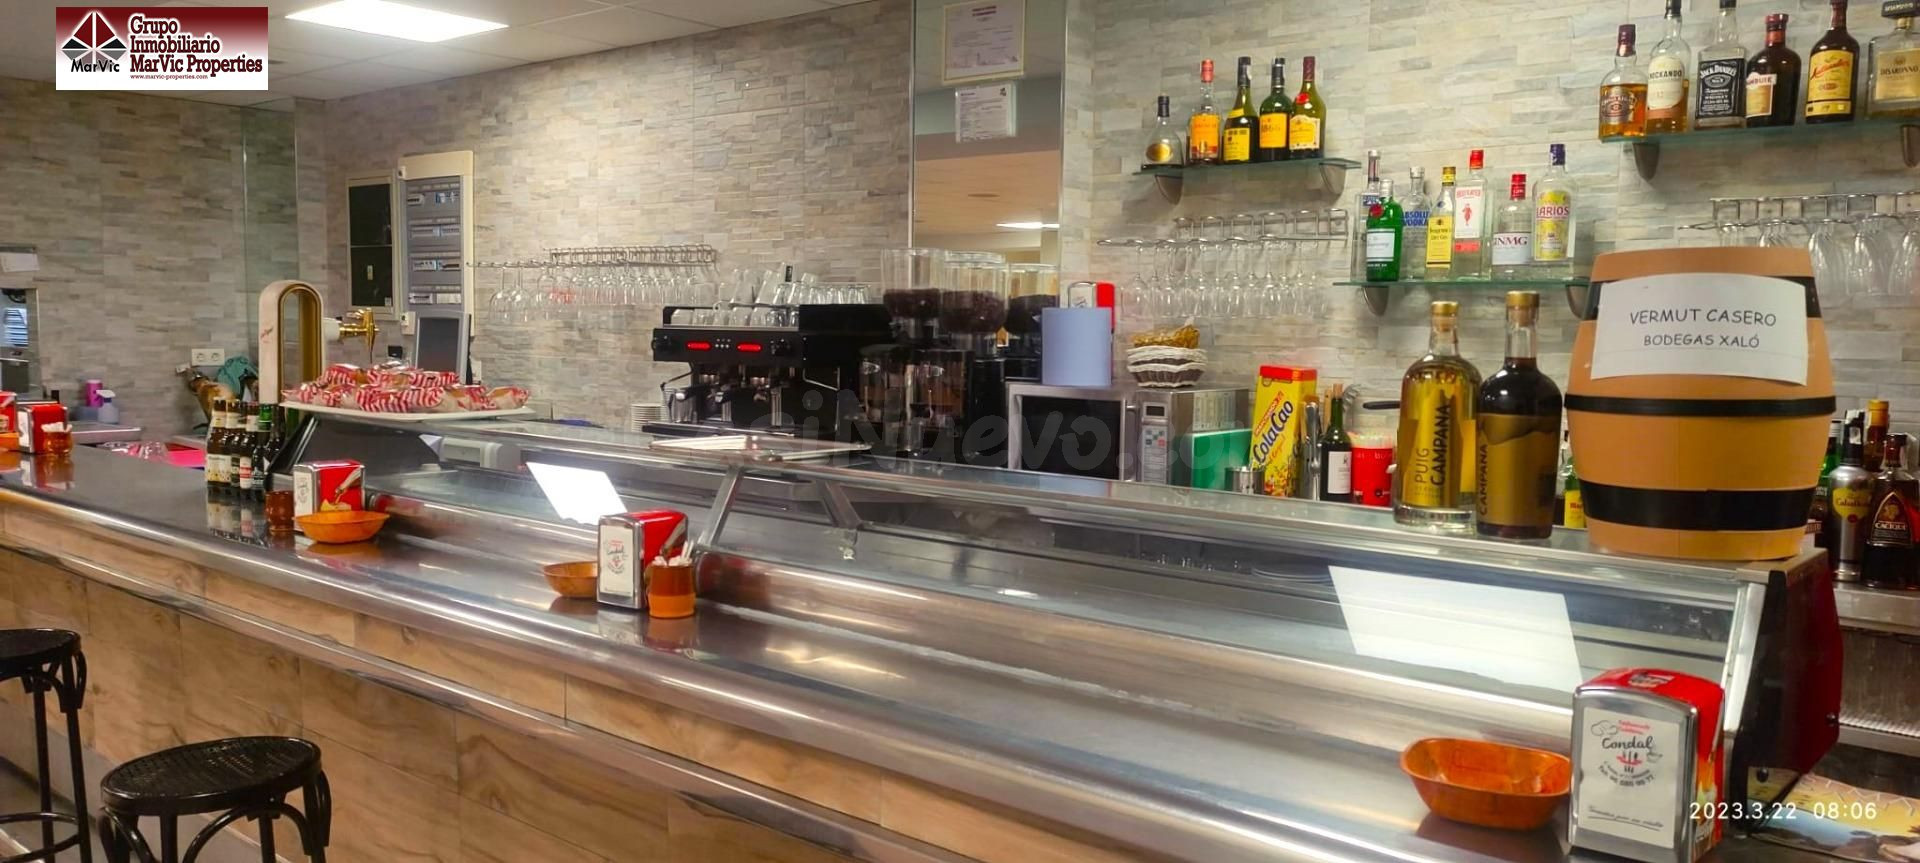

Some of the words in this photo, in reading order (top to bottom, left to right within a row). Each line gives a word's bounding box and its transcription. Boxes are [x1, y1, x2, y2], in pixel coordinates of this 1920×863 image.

[1536, 206, 1569, 217] LARIOS
[1630, 309, 1701, 325] VERMUT
[1706, 309, 1777, 327] CASERO
[1644, 332, 1714, 346] BODEGAS
[1719, 334, 1760, 348] XALÓ
[1253, 400, 1293, 464] ColaCao
[1430, 404, 1450, 486] CAMPANA
[1415, 448, 1429, 484] PUIG
[1479, 443, 1489, 516] CAMPANA
[1601, 735, 1655, 750] Condal
